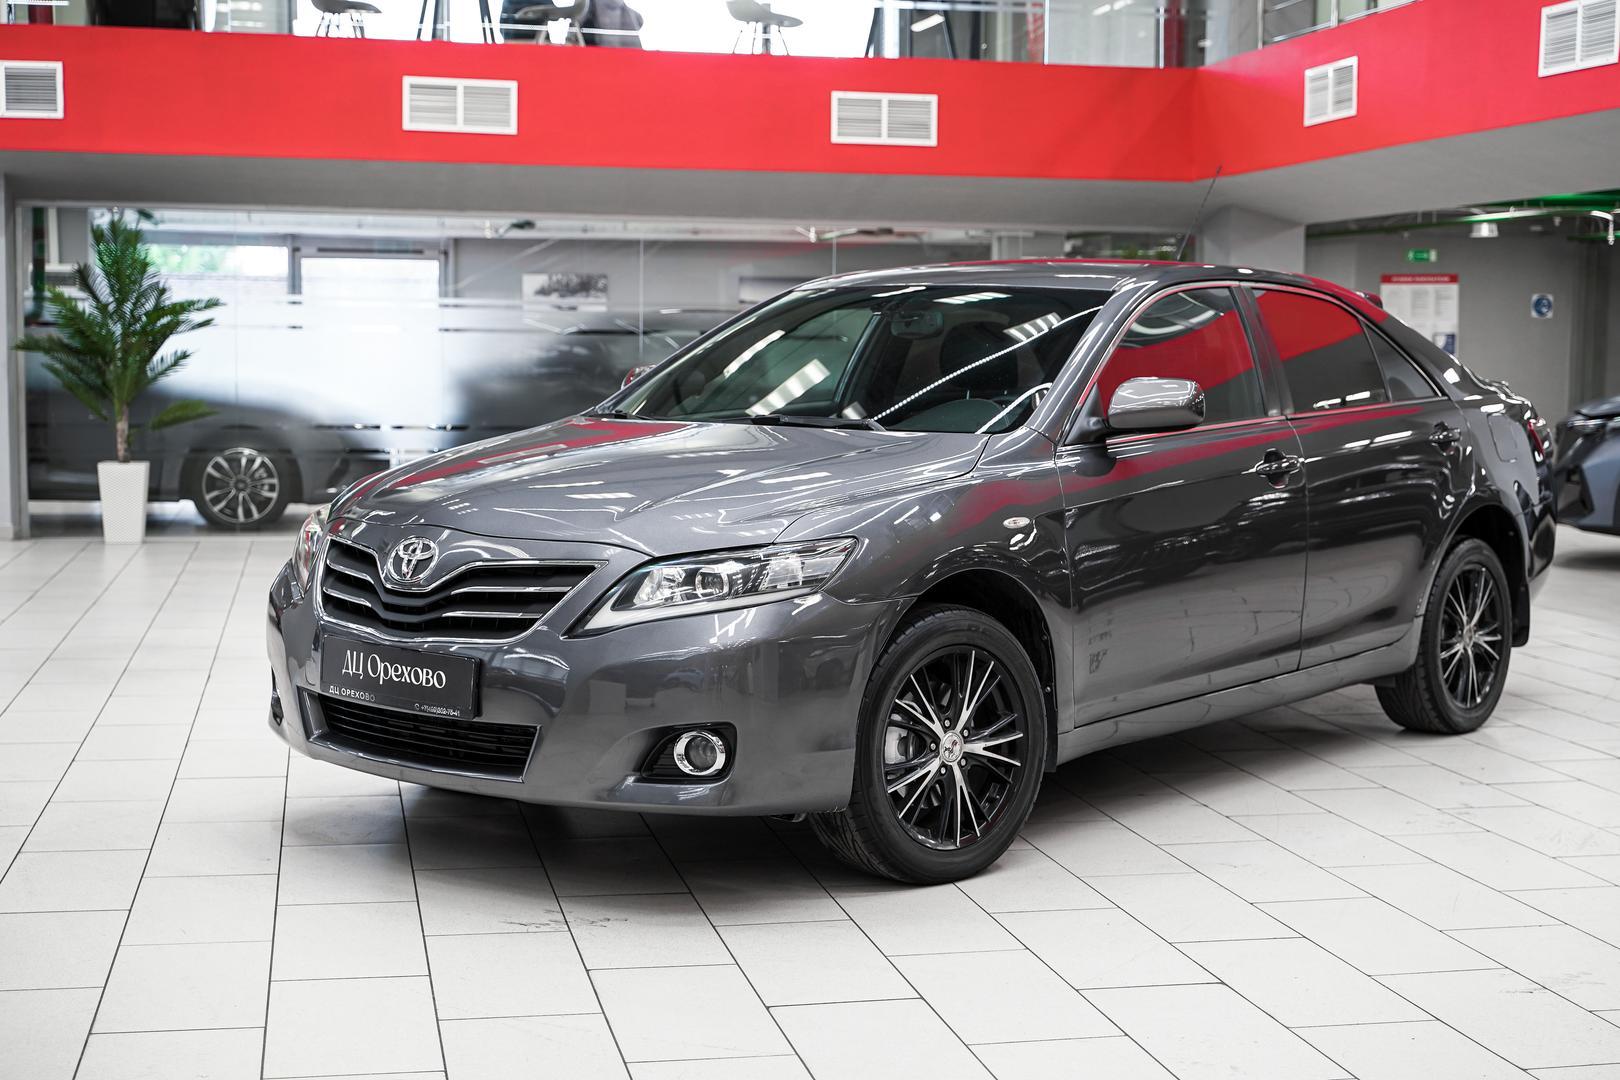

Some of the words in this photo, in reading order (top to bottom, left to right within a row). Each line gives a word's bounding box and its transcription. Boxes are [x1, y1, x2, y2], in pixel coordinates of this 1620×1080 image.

[342, 649, 363, 679] ДЦ
[367, 653, 446, 689] Орехово
[329, 685, 340, 696] ДЦ
[341, 688, 376, 702] ОРЕХОВО
